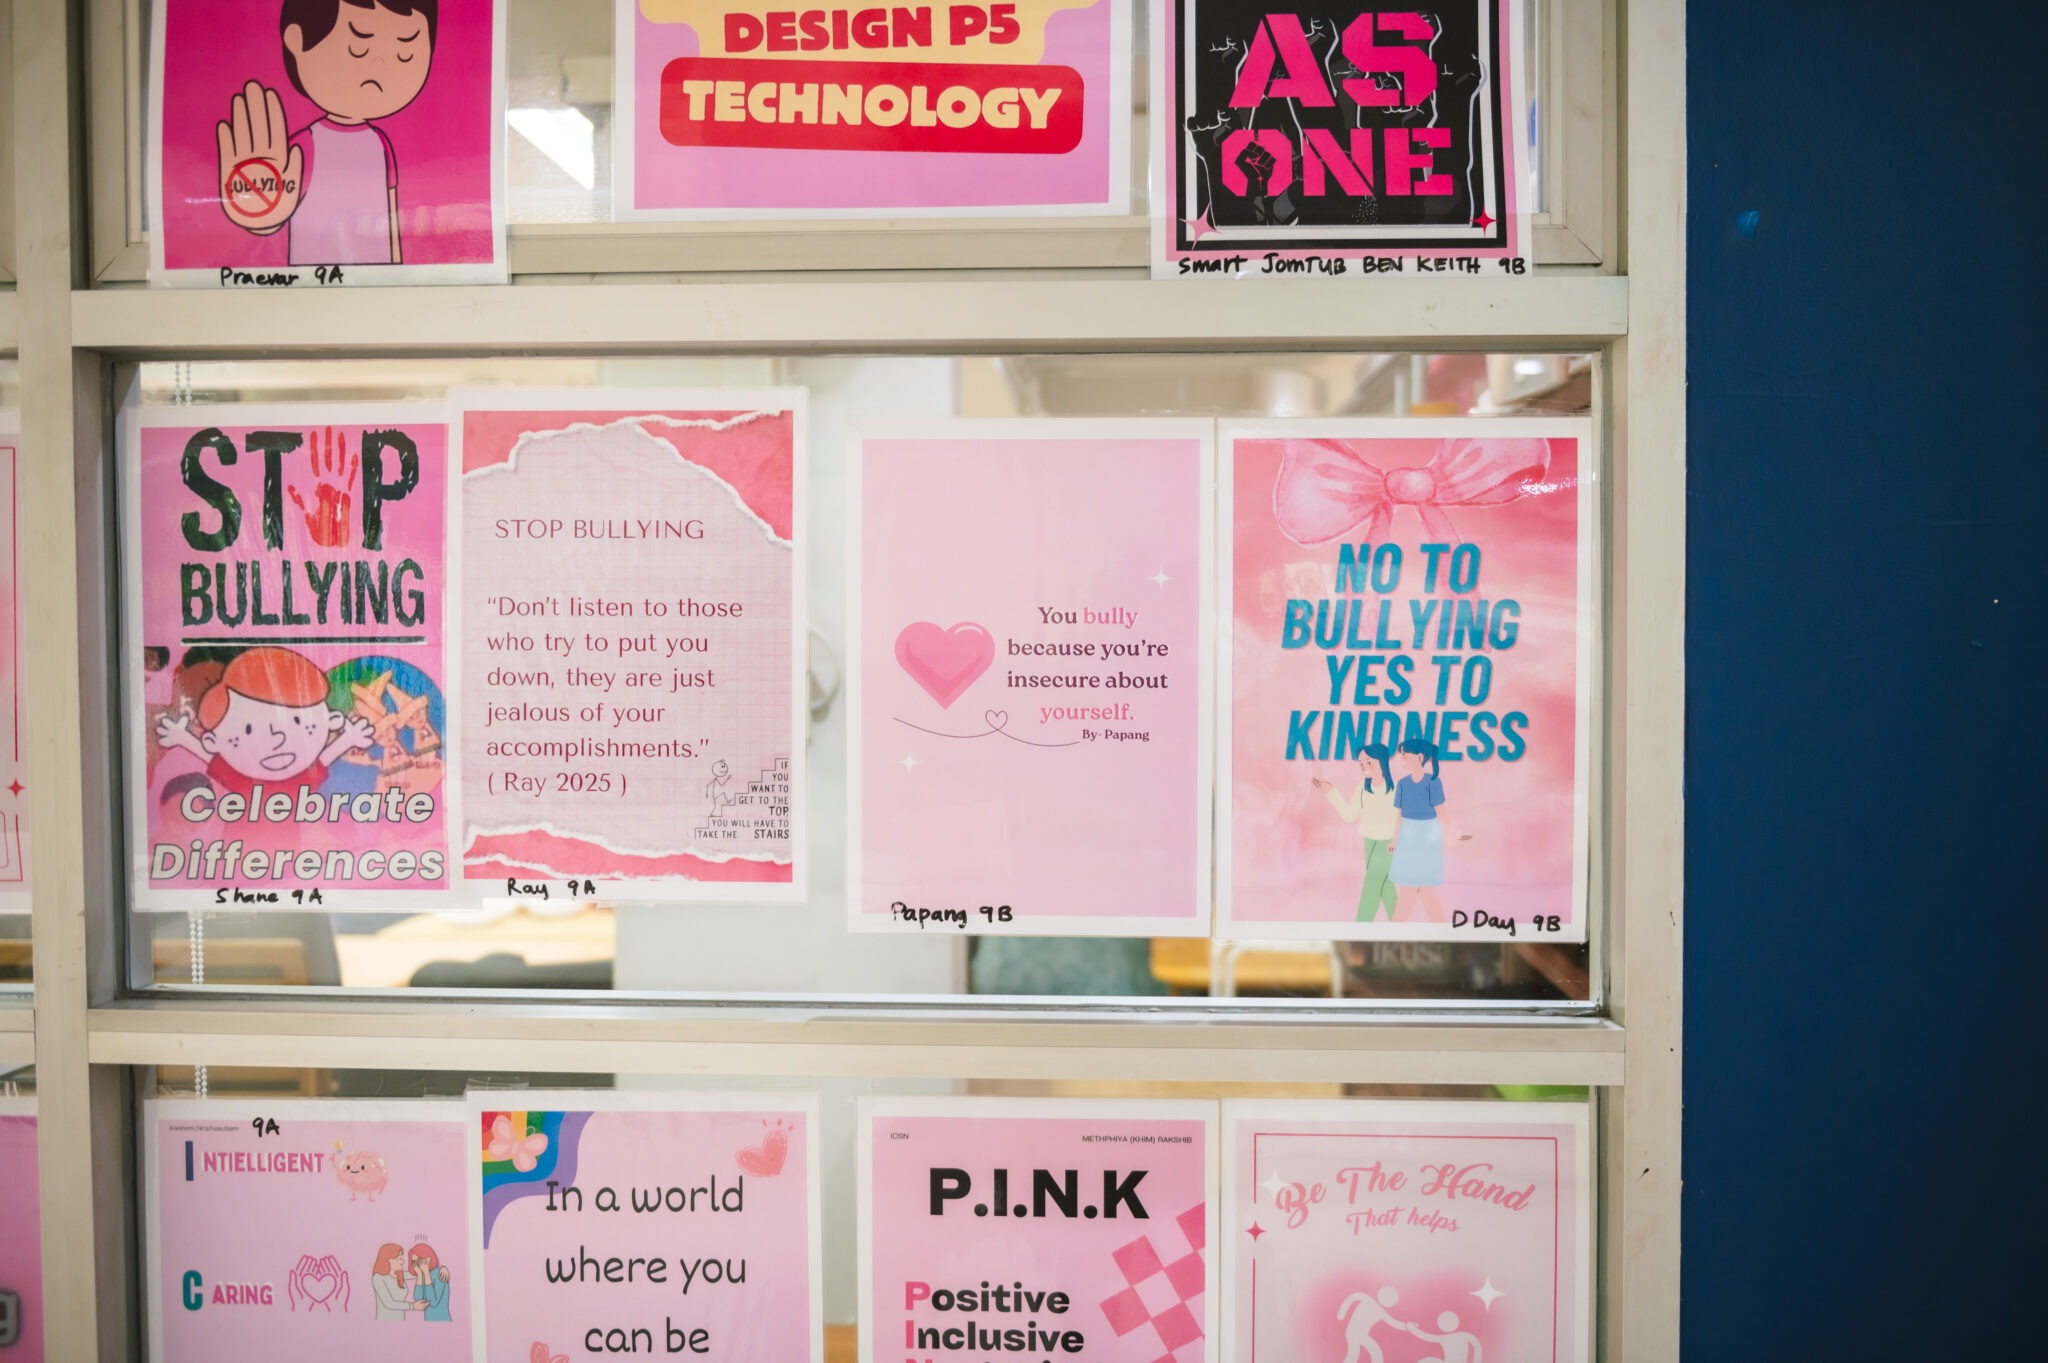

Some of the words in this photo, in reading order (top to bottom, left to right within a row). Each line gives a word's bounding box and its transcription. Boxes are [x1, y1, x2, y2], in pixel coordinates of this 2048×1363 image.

[724, 6, 932, 53] DESIGN
[949, 4, 1021, 46] P5
[1228, 12, 1437, 108] AS
[682, 79, 1062, 130] TECHNOLOGY
[1221, 127, 1454, 197] ONE
[314, 265, 344, 285] 9A
[1363, 256, 1403, 273] BEN
[1416, 256, 1481, 274] KEITH
[1498, 257, 1526, 275] 9B
[494, 519, 563, 540] STOP
[573, 519, 704, 540] BULLYING
[1334, 543, 1403, 594] NO
[1419, 543, 1481, 594] TO
[180, 558, 425, 628] BULLYING
[569, 598, 633, 617] listen
[643, 599, 668, 617] to
[677, 598, 743, 618] those
[1038, 607, 1078, 625] You
[1083, 607, 1138, 629] bully
[1281, 598, 1521, 650] BULLYING
[487, 632, 534, 652] who
[544, 633, 575, 657] try
[584, 633, 609, 652] to
[618, 634, 657, 657] put
[666, 638, 709, 658] you
[1007, 639, 1096, 657] because
[487, 667, 555, 689] down,
[566, 668, 616, 692] they
[625, 671, 663, 687] are
[670, 668, 716, 693] just
[1007, 671, 1100, 688] insecure
[1105, 672, 1168, 689] about
[1325, 654, 1414, 706] YES
[1430, 654, 1492, 706] TO
[485, 702, 570, 727] jealous
[580, 703, 604, 722] of
[612, 706, 666, 728] your
[1040, 703, 1135, 725] yourself.
[1104, 729, 1150, 742] Papang
[1284, 709, 1530, 763] KINDNESS
[772, 773, 789, 782] YOU
[781, 761, 788, 769] IF
[504, 772, 547, 797] Ray
[556, 772, 611, 793] 2025
[751, 785, 775, 793] WANT
[779, 785, 789, 793] TO
[180, 784, 434, 823] Celebrate
[738, 796, 753, 805] GET
[759, 796, 769, 805] TO
[773, 796, 789, 805] THE
[698, 830, 718, 839] TAKE
[722, 830, 737, 839] THE
[754, 829, 790, 840] STAIRS
[712, 819, 728, 828] YOU
[731, 819, 751, 828] WILL
[754, 819, 775, 828] HAVE
[779, 819, 789, 828] TO
[150, 839, 445, 881] Differences
[215, 887, 279, 904] Shane
[291, 888, 323, 905] 9A
[507, 877, 549, 900] Ray
[567, 879, 596, 897] 9A
[891, 901, 968, 929] Papang
[979, 905, 1013, 923] 9B
[1532, 915, 1561, 932] 9B
[252, 1117, 280, 1138] 9A
[546, 1180, 583, 1212] In
[595, 1186, 621, 1212] a
[631, 1174, 744, 1213] world
[929, 1167, 1150, 1219] P.I.N.K
[1275, 1182, 1327, 1229] Be
[1336, 1161, 1407, 1205] The
[1420, 1163, 1537, 1211] Hand
[1346, 1208, 1403, 1236] That
[1407, 1206, 1460, 1233] helps
[545, 1245, 668, 1284] where
[680, 1258, 746, 1295] you
[905, 1280, 1070, 1314] Positive
[585, 1328, 653, 1354] can
[665, 1316, 710, 1354] be
[905, 1319, 1085, 1354] Inclusive
